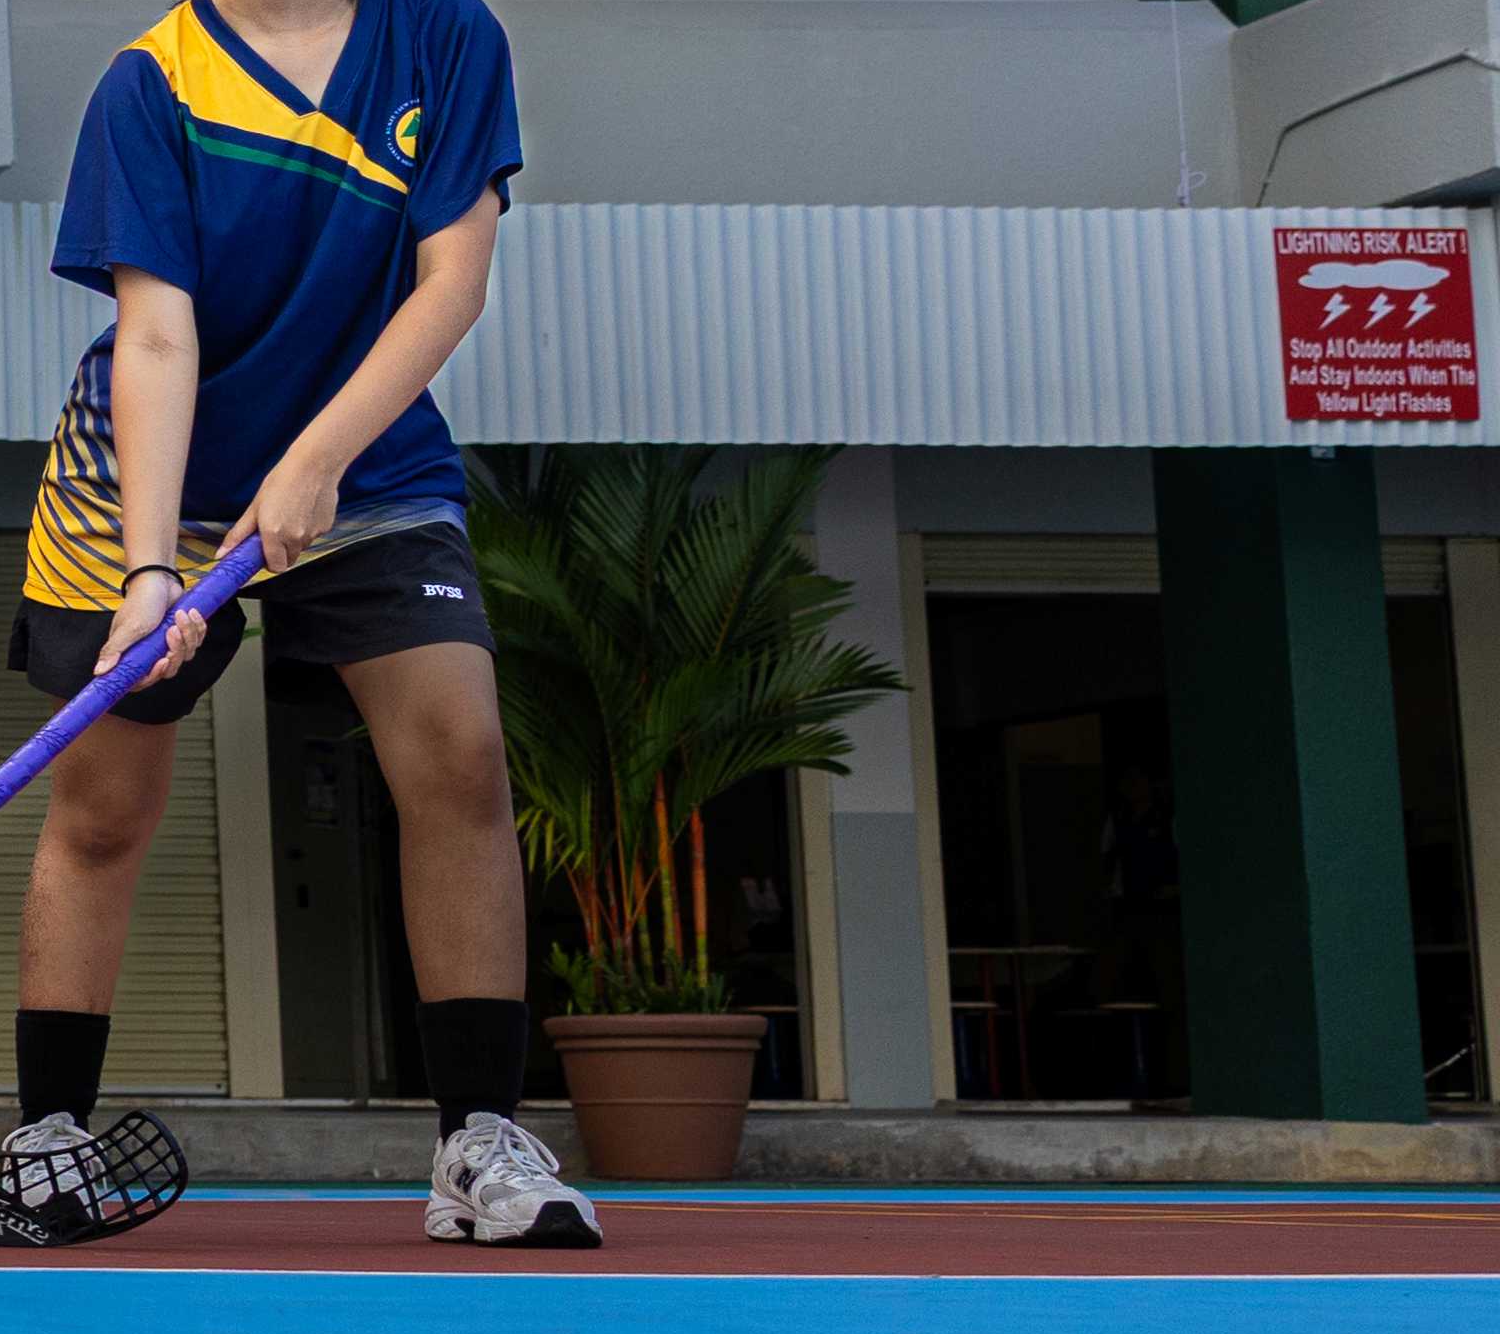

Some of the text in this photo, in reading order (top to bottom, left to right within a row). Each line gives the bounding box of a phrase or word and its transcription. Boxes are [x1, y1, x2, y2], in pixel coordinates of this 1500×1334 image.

[1278, 233, 1360, 254] LIGHTNING
[1364, 233, 1401, 254] RISK
[1406, 233, 1456, 253] ALERT
[1291, 338, 1471, 362] Stop All Outdoor Activities
[1290, 366, 1475, 390] And Stay Indoors When The
[1318, 393, 1451, 416] Yellow Light Flashes
[422, 584, 464, 599] BVSS
